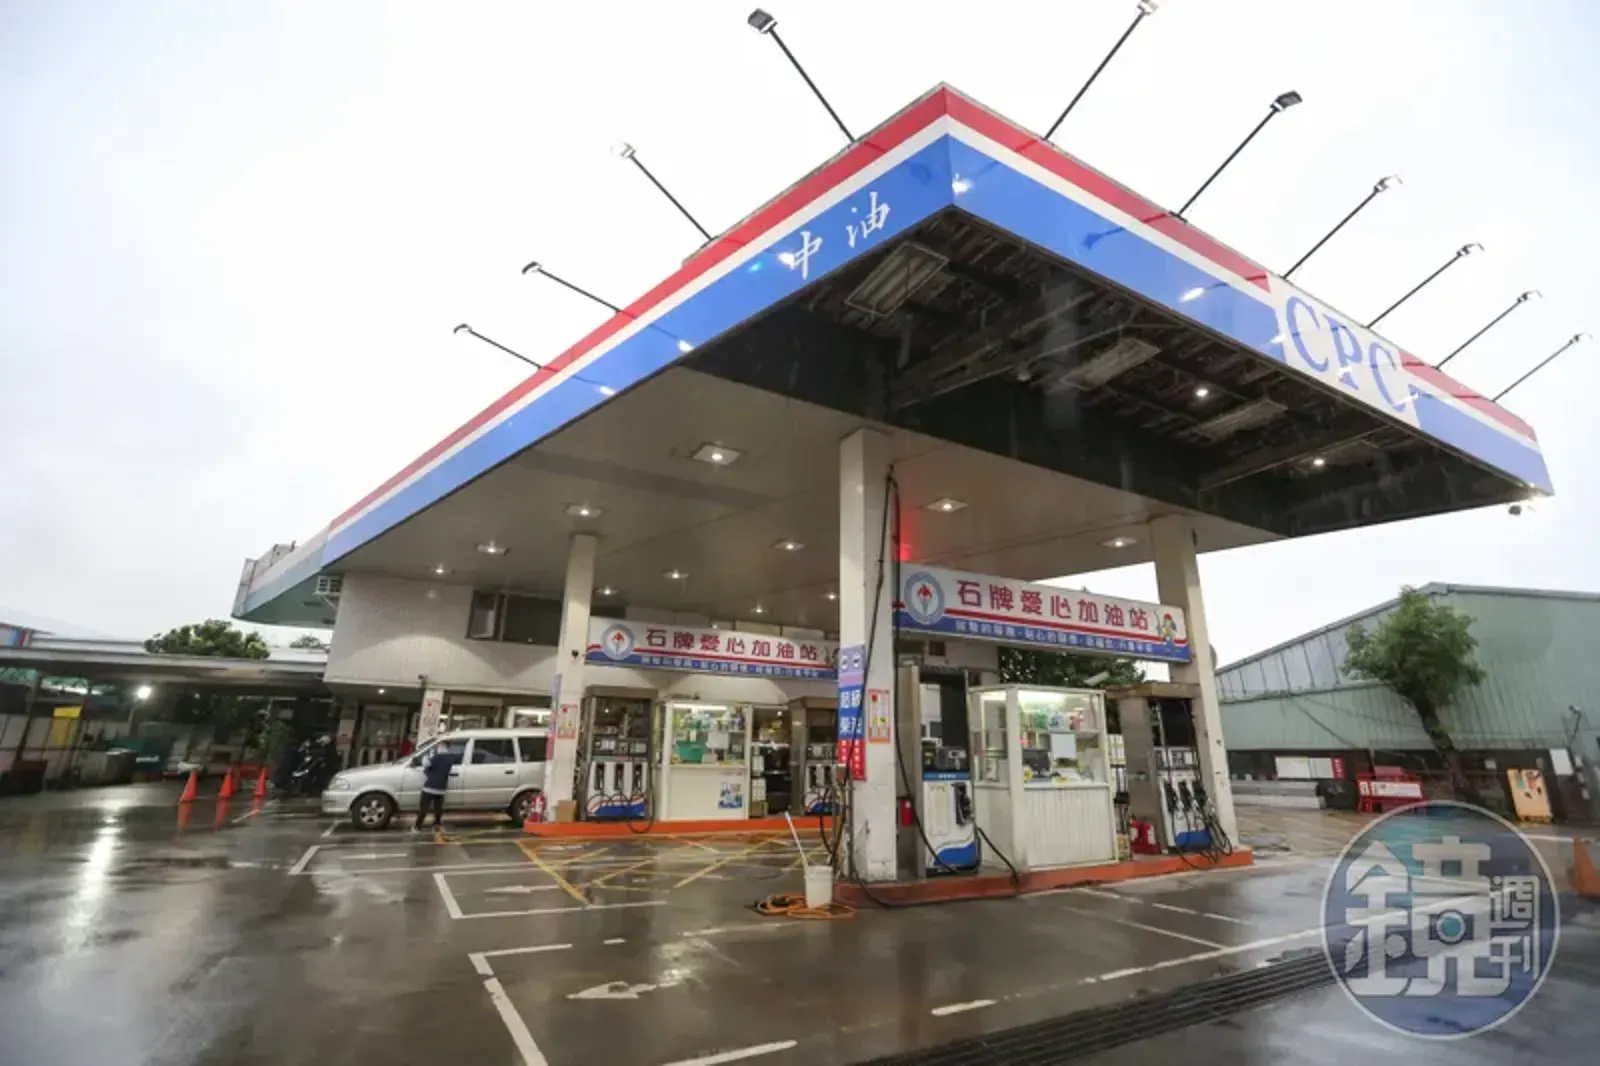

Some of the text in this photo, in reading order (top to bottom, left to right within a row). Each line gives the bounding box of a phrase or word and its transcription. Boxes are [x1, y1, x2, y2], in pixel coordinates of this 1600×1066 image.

[780, 191, 891, 281] 中油
[1286, 295, 1406, 413] CPC
[956, 579, 1150, 631] 石牌愛心加油站
[645, 628, 819, 662] 石牌愛心加油站
